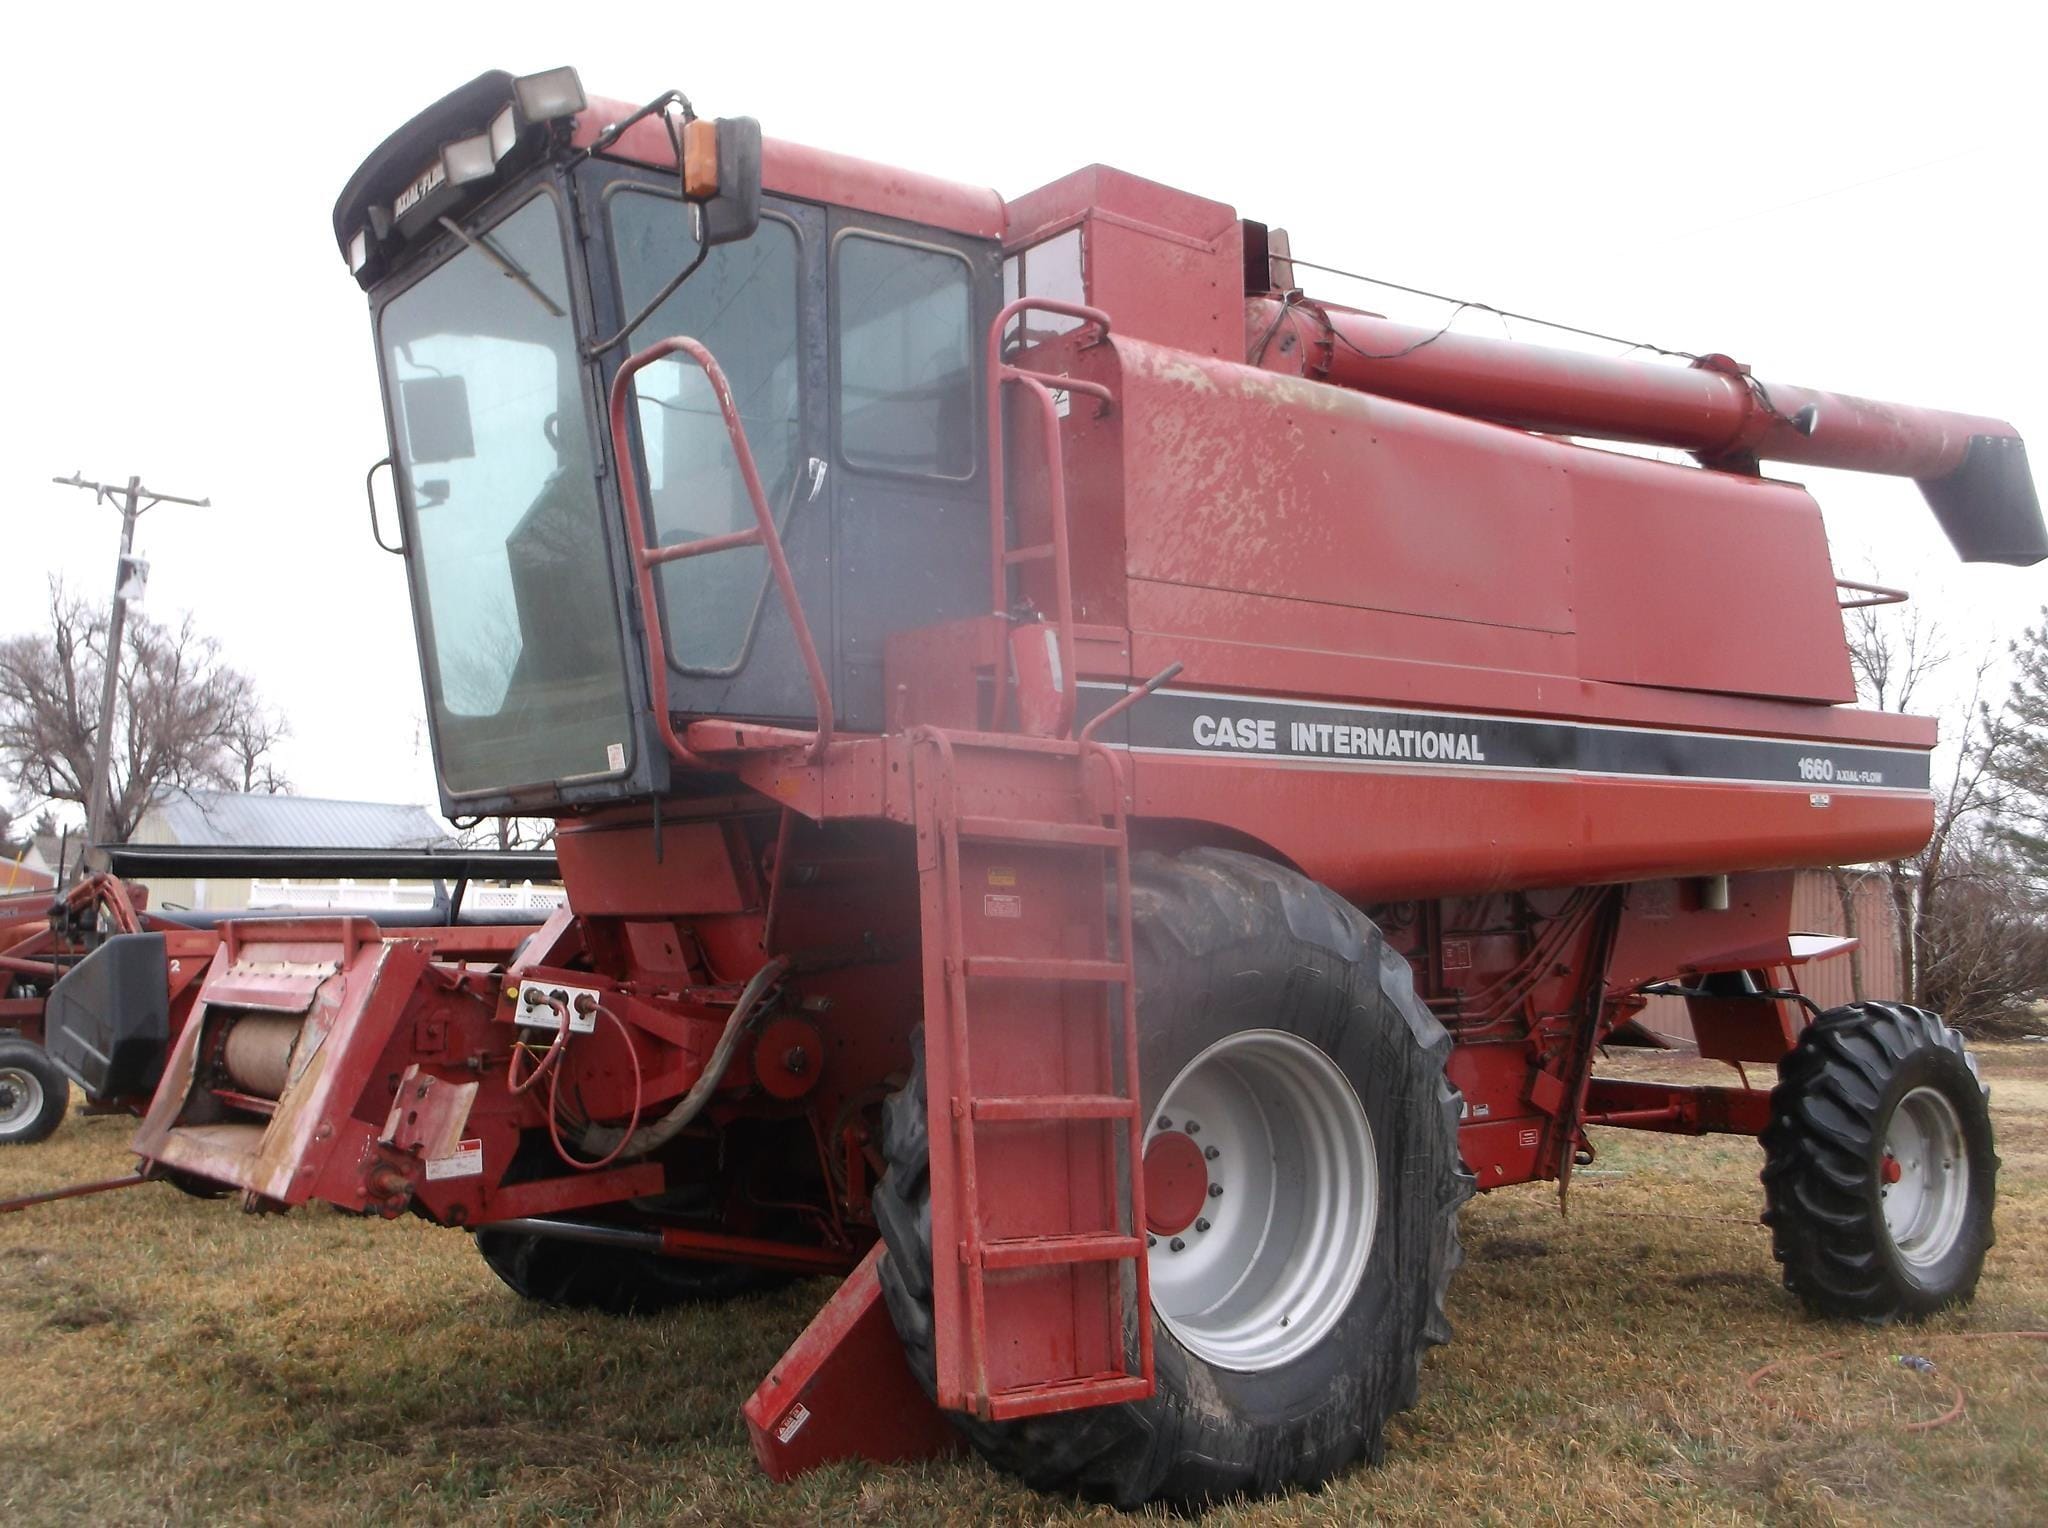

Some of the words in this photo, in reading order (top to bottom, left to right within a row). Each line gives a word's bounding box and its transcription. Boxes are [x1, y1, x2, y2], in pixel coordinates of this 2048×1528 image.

[1192, 715, 1276, 749] CASE
[1290, 722, 1485, 761] INTERNATIONAL
[1798, 757, 1834, 781] 1660
[1836, 769, 1883, 784] AXIAL-FLOW
[170, 959, 181, 973] 2
